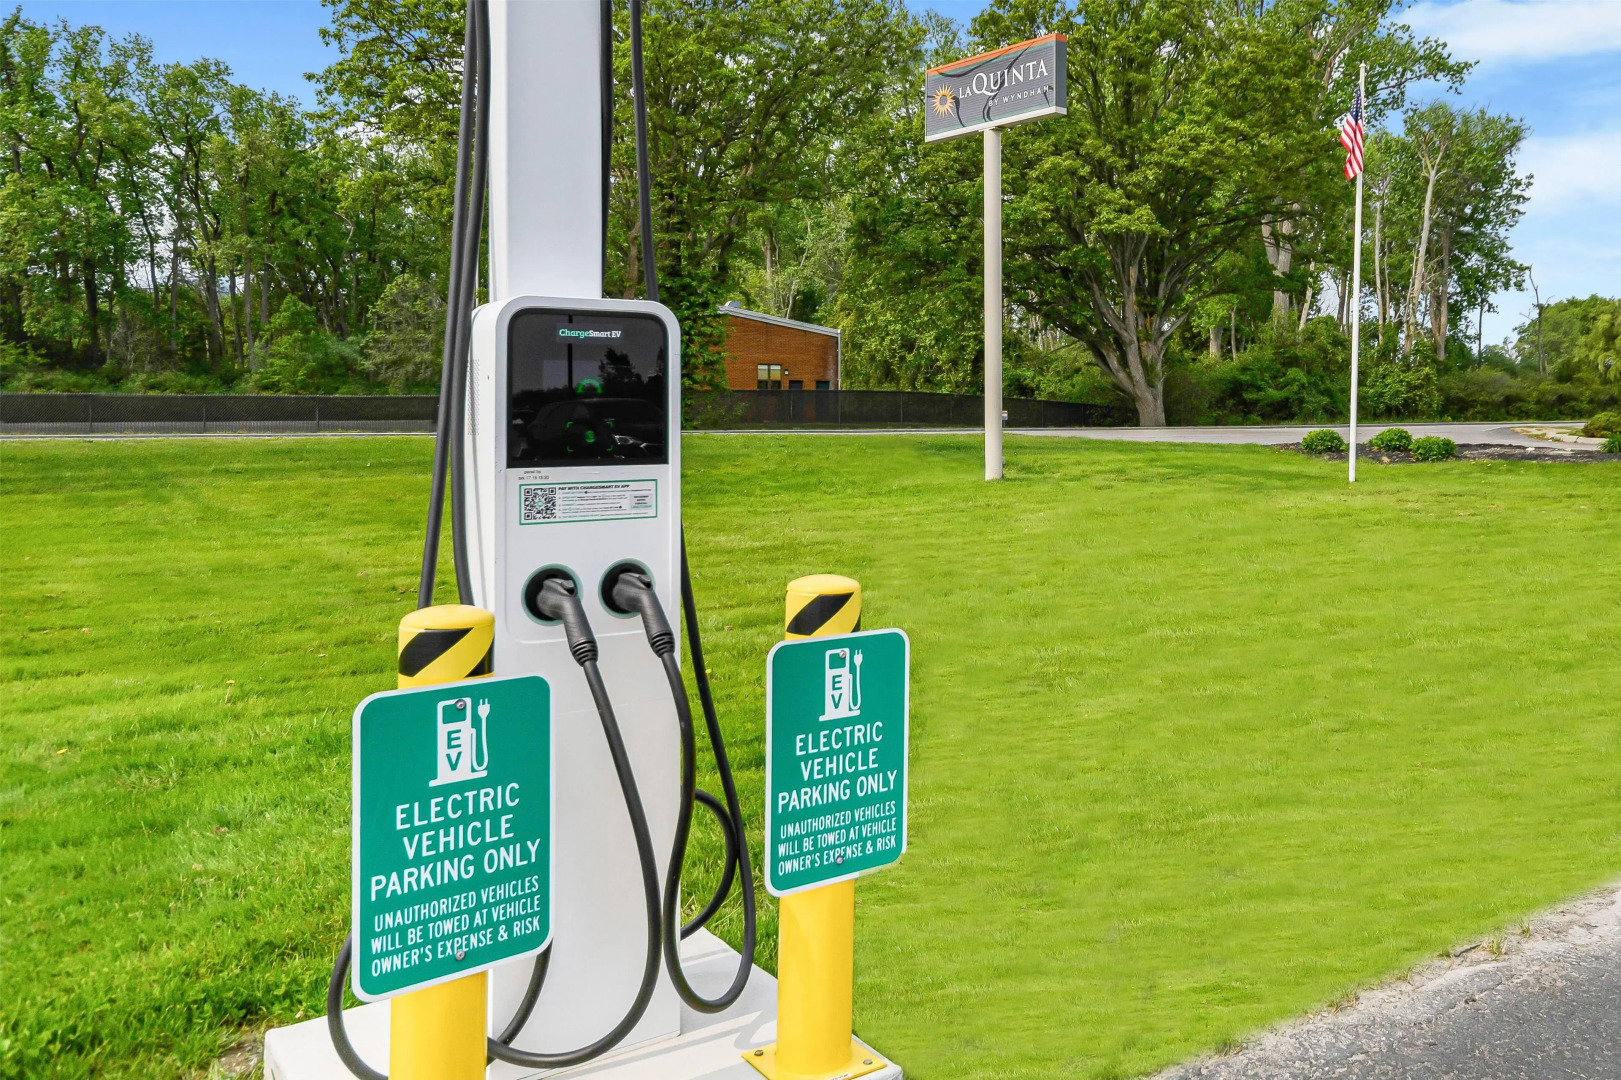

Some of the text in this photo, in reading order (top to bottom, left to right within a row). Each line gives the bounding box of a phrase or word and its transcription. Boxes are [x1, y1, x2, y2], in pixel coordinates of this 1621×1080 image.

[959, 59, 1048, 99] LA QUINTA
[559, 329, 611, 339] ChargeSmart
[796, 721, 883, 756] ELECTRIC
[800, 748, 879, 782] VEHICLE
[396, 782, 520, 830] ELECTRIC
[778, 769, 898, 814] PARKING ONLY
[403, 814, 514, 860] VEHICLE
[778, 817, 896, 858] WILL BE TOWED AT VEHICLE
[780, 800, 896, 839] UNAUTHORIZED VEHICLES
[370, 838, 541, 902] PARKING ONLY
[778, 834, 896, 876] OWNER'S EXPENSE & RISK
[370, 894, 541, 955] WILL BE TOWED AT VEHICLE
[374, 875, 539, 932] UNAUTHORIZED VEHICLES
[371, 915, 540, 977] OWNER'S EXPENSE & RISK
